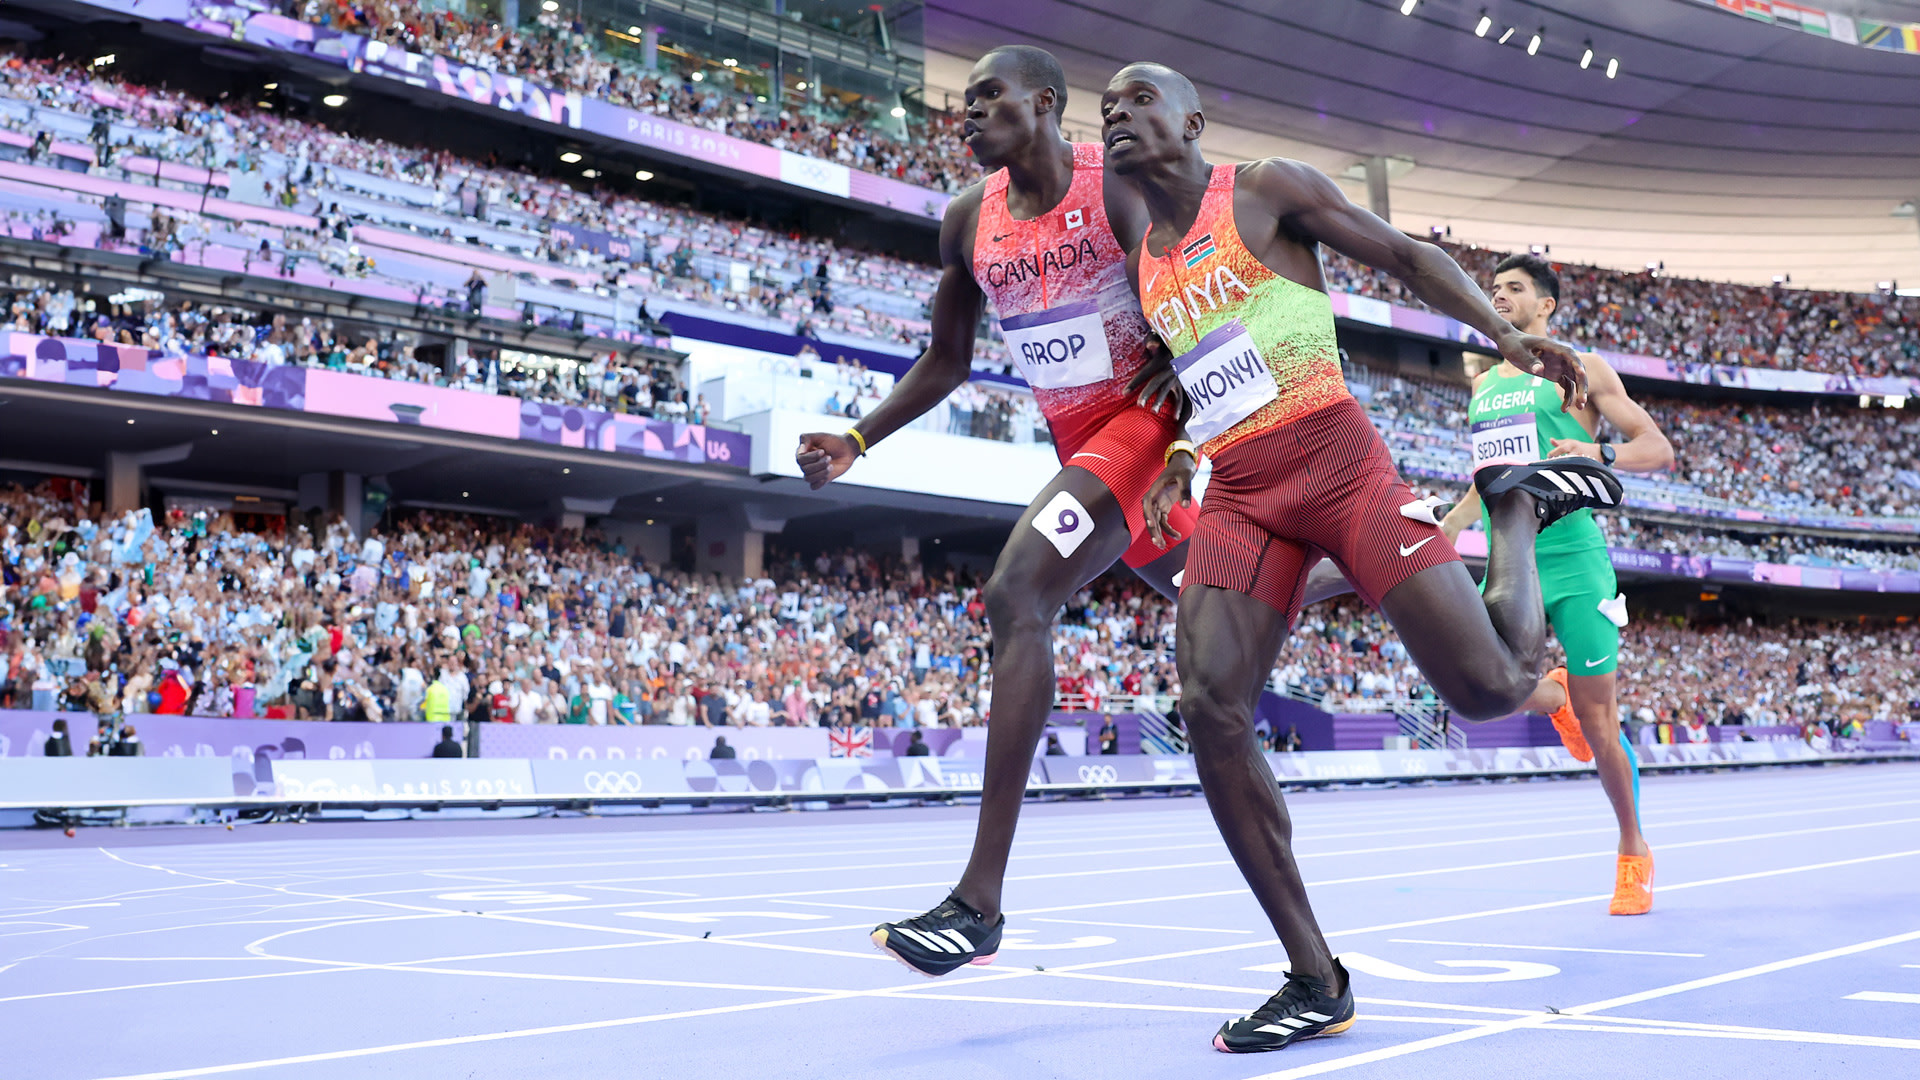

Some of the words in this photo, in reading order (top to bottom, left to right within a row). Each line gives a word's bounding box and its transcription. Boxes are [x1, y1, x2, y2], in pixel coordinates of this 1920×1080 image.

[627, 118, 685, 145] PARIS
[690, 134, 740, 160] 2024
[987, 238, 1098, 288] CANADA
[1149, 265, 1251, 342] KENYA
[1021, 333, 1086, 365] AROP
[1476, 389, 1536, 416] ALGERIA
[707, 440, 731, 461] U6
[1477, 435, 1531, 460] SEDJATI
[1054, 508, 1080, 535] 9
[460, 779, 523, 797] 2024
[1239, 951, 1561, 983] 2
